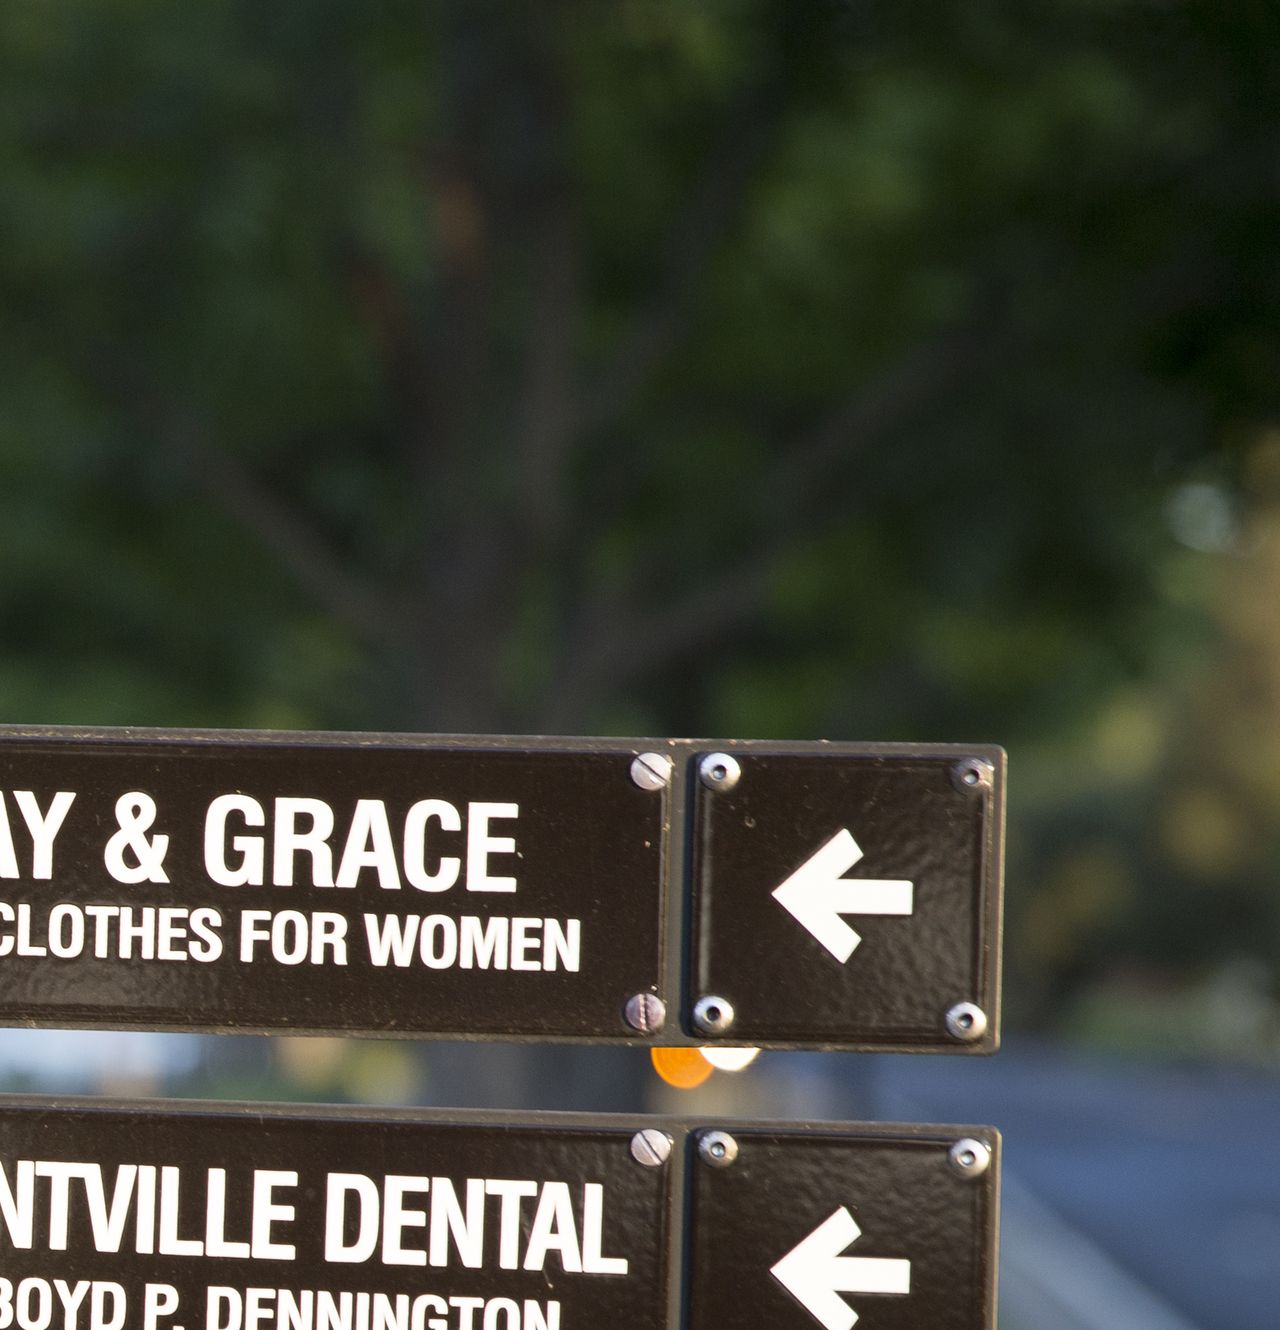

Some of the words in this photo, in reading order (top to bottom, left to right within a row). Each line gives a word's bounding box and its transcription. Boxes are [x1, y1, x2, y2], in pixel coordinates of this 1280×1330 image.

[103, 791, 171, 885] &
[203, 793, 519, 893] GRACE
[239, 909, 349, 966] FOR
[363, 912, 581, 973] WOMEN
[324, 1172, 629, 1275] DENTAL
